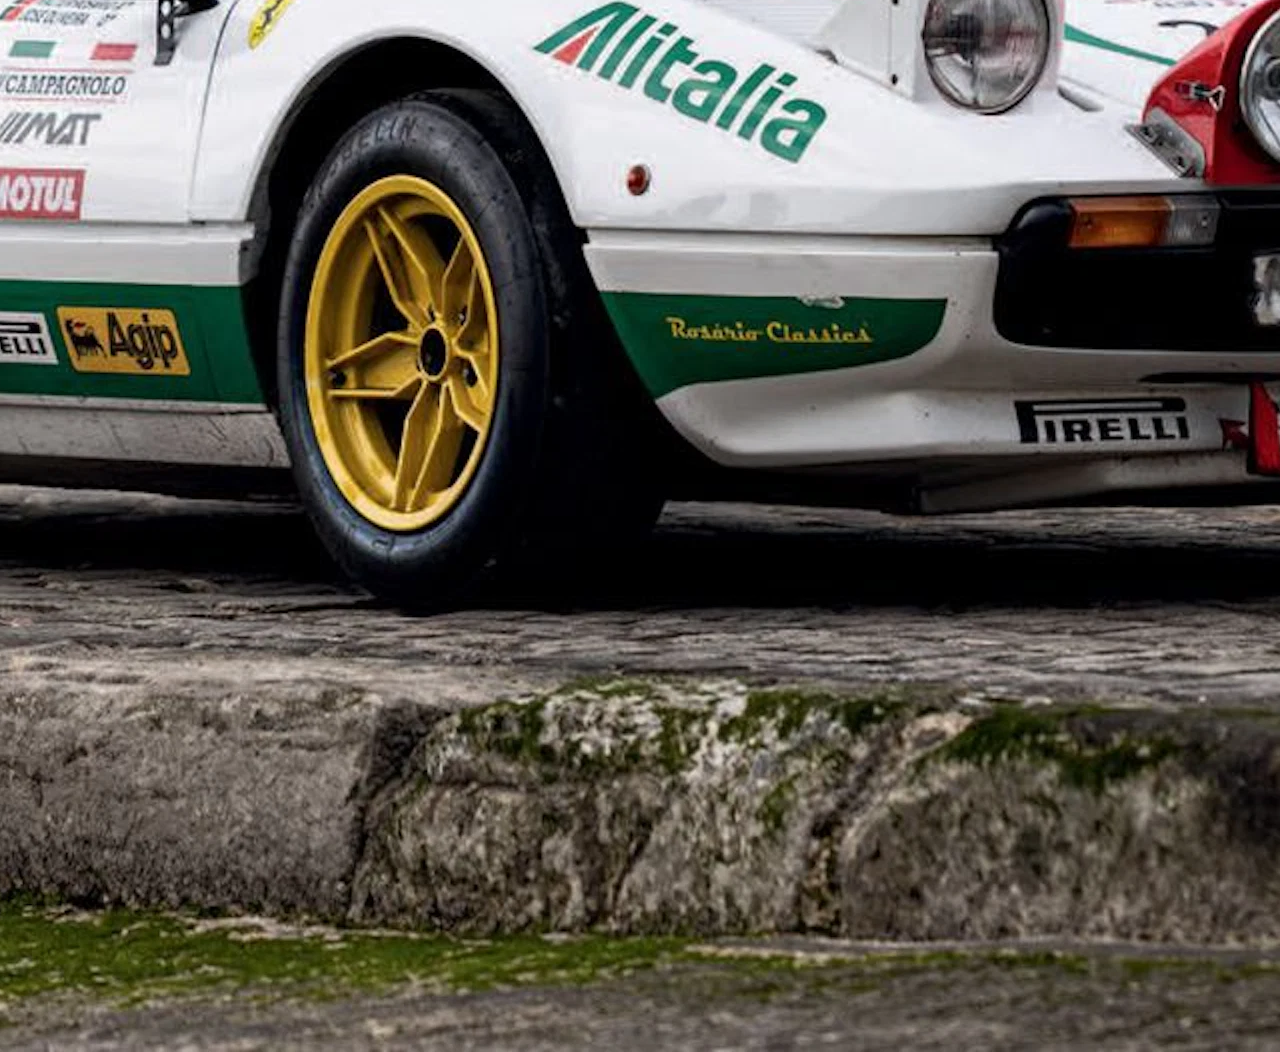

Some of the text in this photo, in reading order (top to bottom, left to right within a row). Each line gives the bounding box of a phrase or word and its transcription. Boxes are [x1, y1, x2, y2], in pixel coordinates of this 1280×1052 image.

[5, 74, 125, 95] CAMPAGNOLO
[533, 1, 827, 164] Alitalia
[107, 312, 178, 369] Agip
[766, 321, 874, 344] Classics
[1015, 397, 1191, 444] PIRELLI
